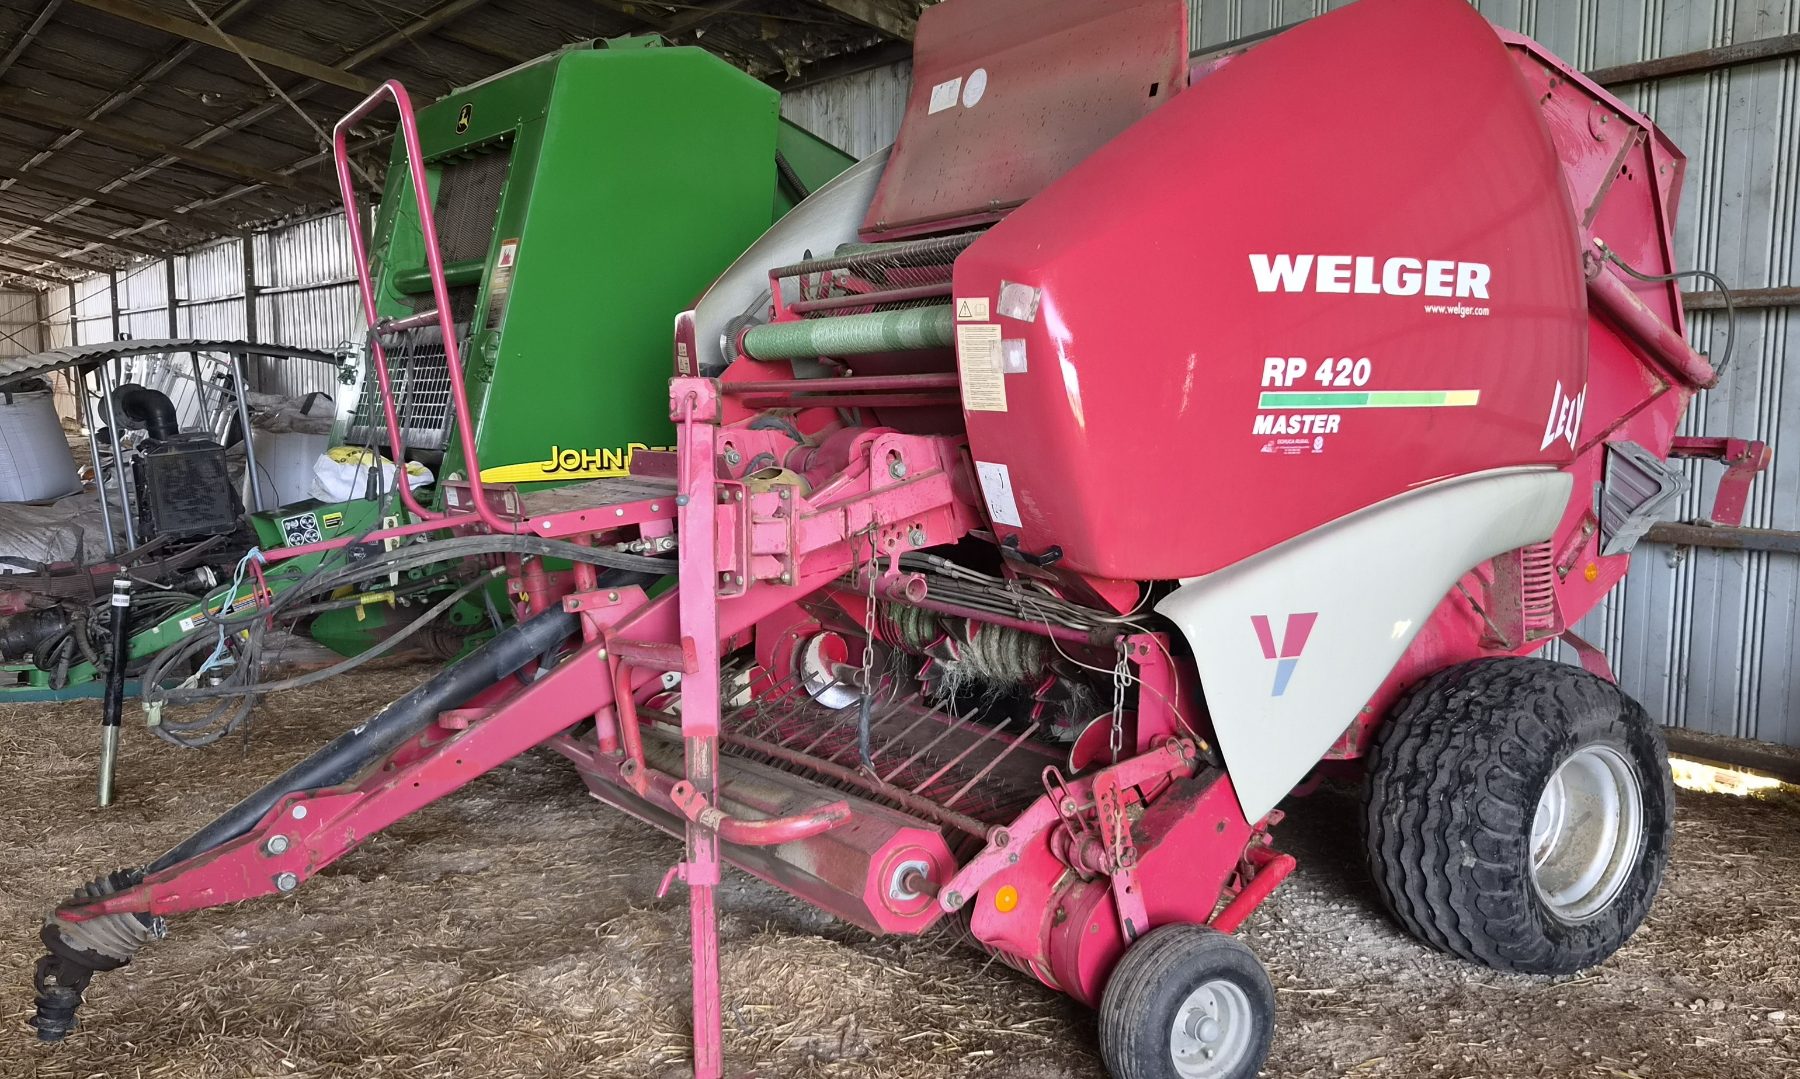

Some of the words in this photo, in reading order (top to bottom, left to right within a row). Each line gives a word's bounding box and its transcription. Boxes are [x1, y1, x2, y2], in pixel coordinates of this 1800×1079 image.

[1248, 253, 1491, 299] WELGER
[1424, 302, 1490, 318] www.welger.com
[1260, 357, 1307, 387] RP
[1314, 357, 1372, 387] 420
[1252, 414, 1341, 435] MASTER
[1540, 379, 1587, 452] LELY
[542, 445, 624, 473] JOHN
